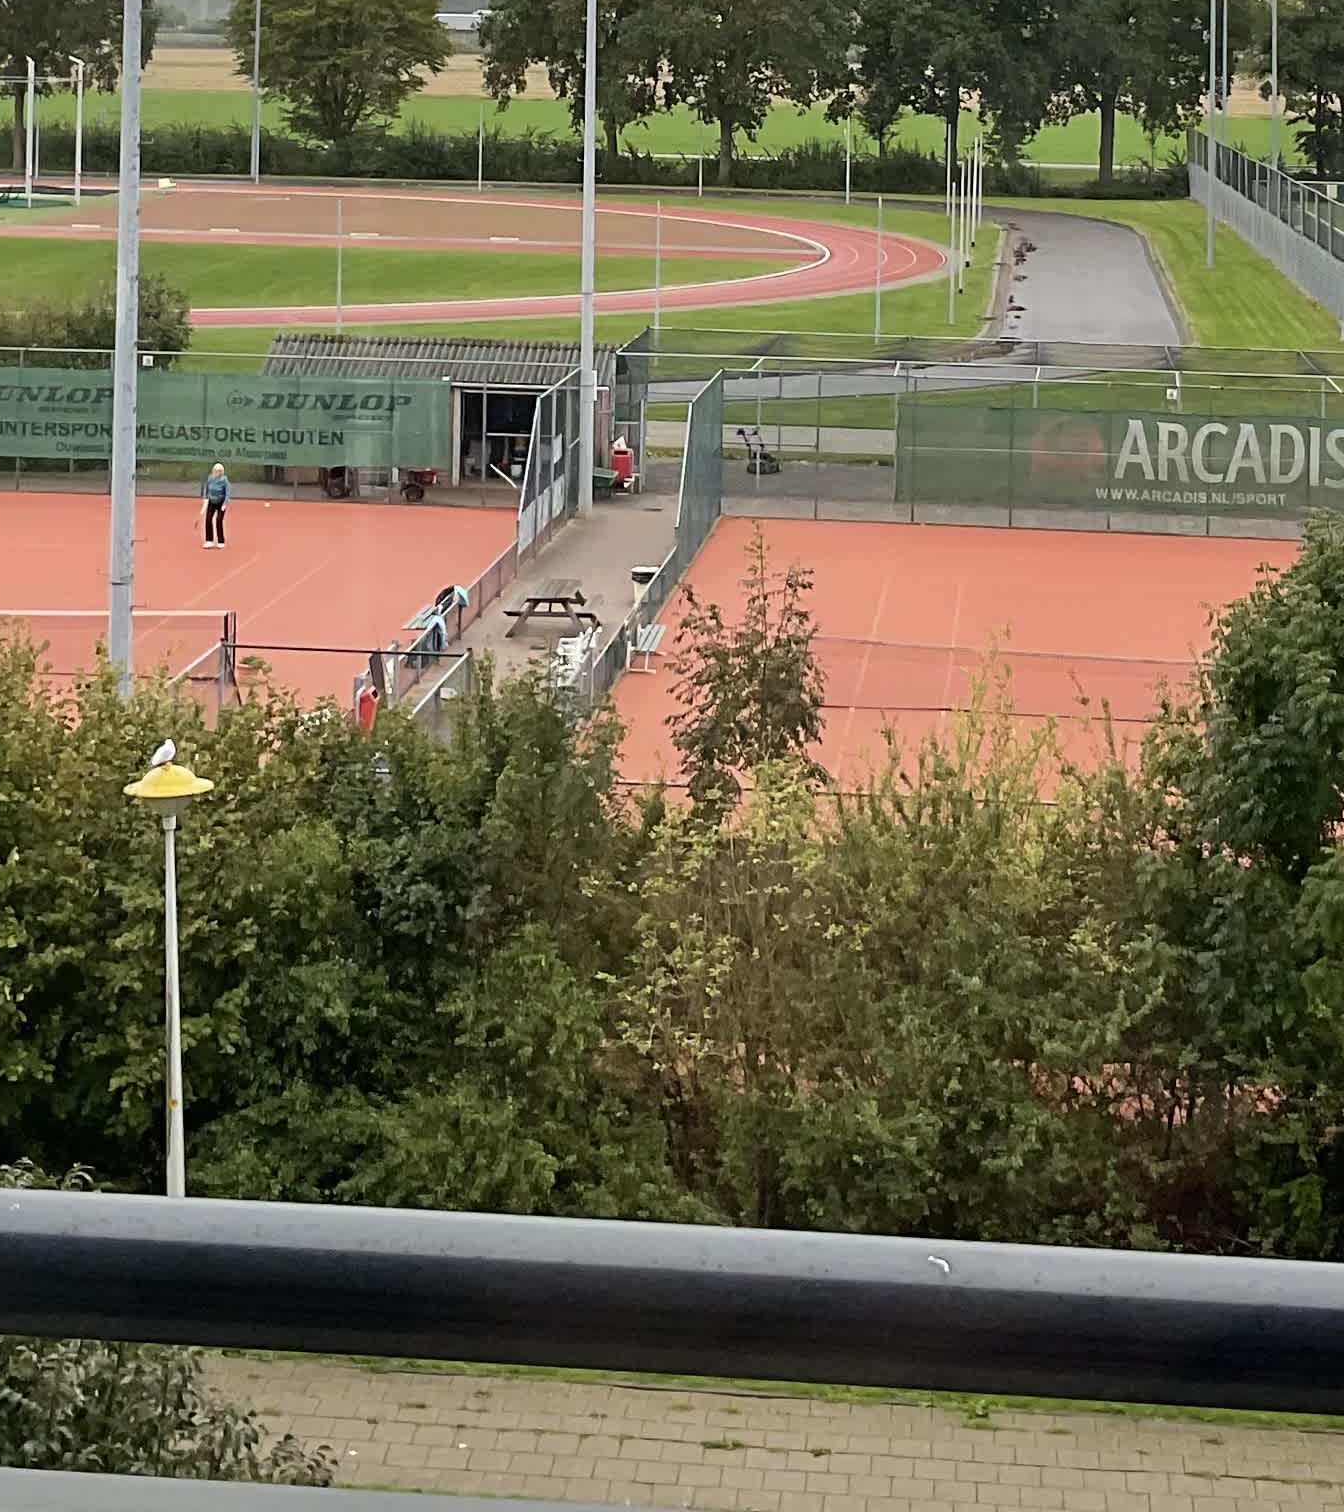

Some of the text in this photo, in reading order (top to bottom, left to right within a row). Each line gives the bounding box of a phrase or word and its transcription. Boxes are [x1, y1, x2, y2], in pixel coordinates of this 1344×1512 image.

[258, 393, 412, 411] DUNLOP
[0, 421, 113, 438] INTERSPOR
[263, 429, 344, 445] HOUTEN
[1095, 488, 1286, 505] WWW.ARCADIS.NL/SPORT
